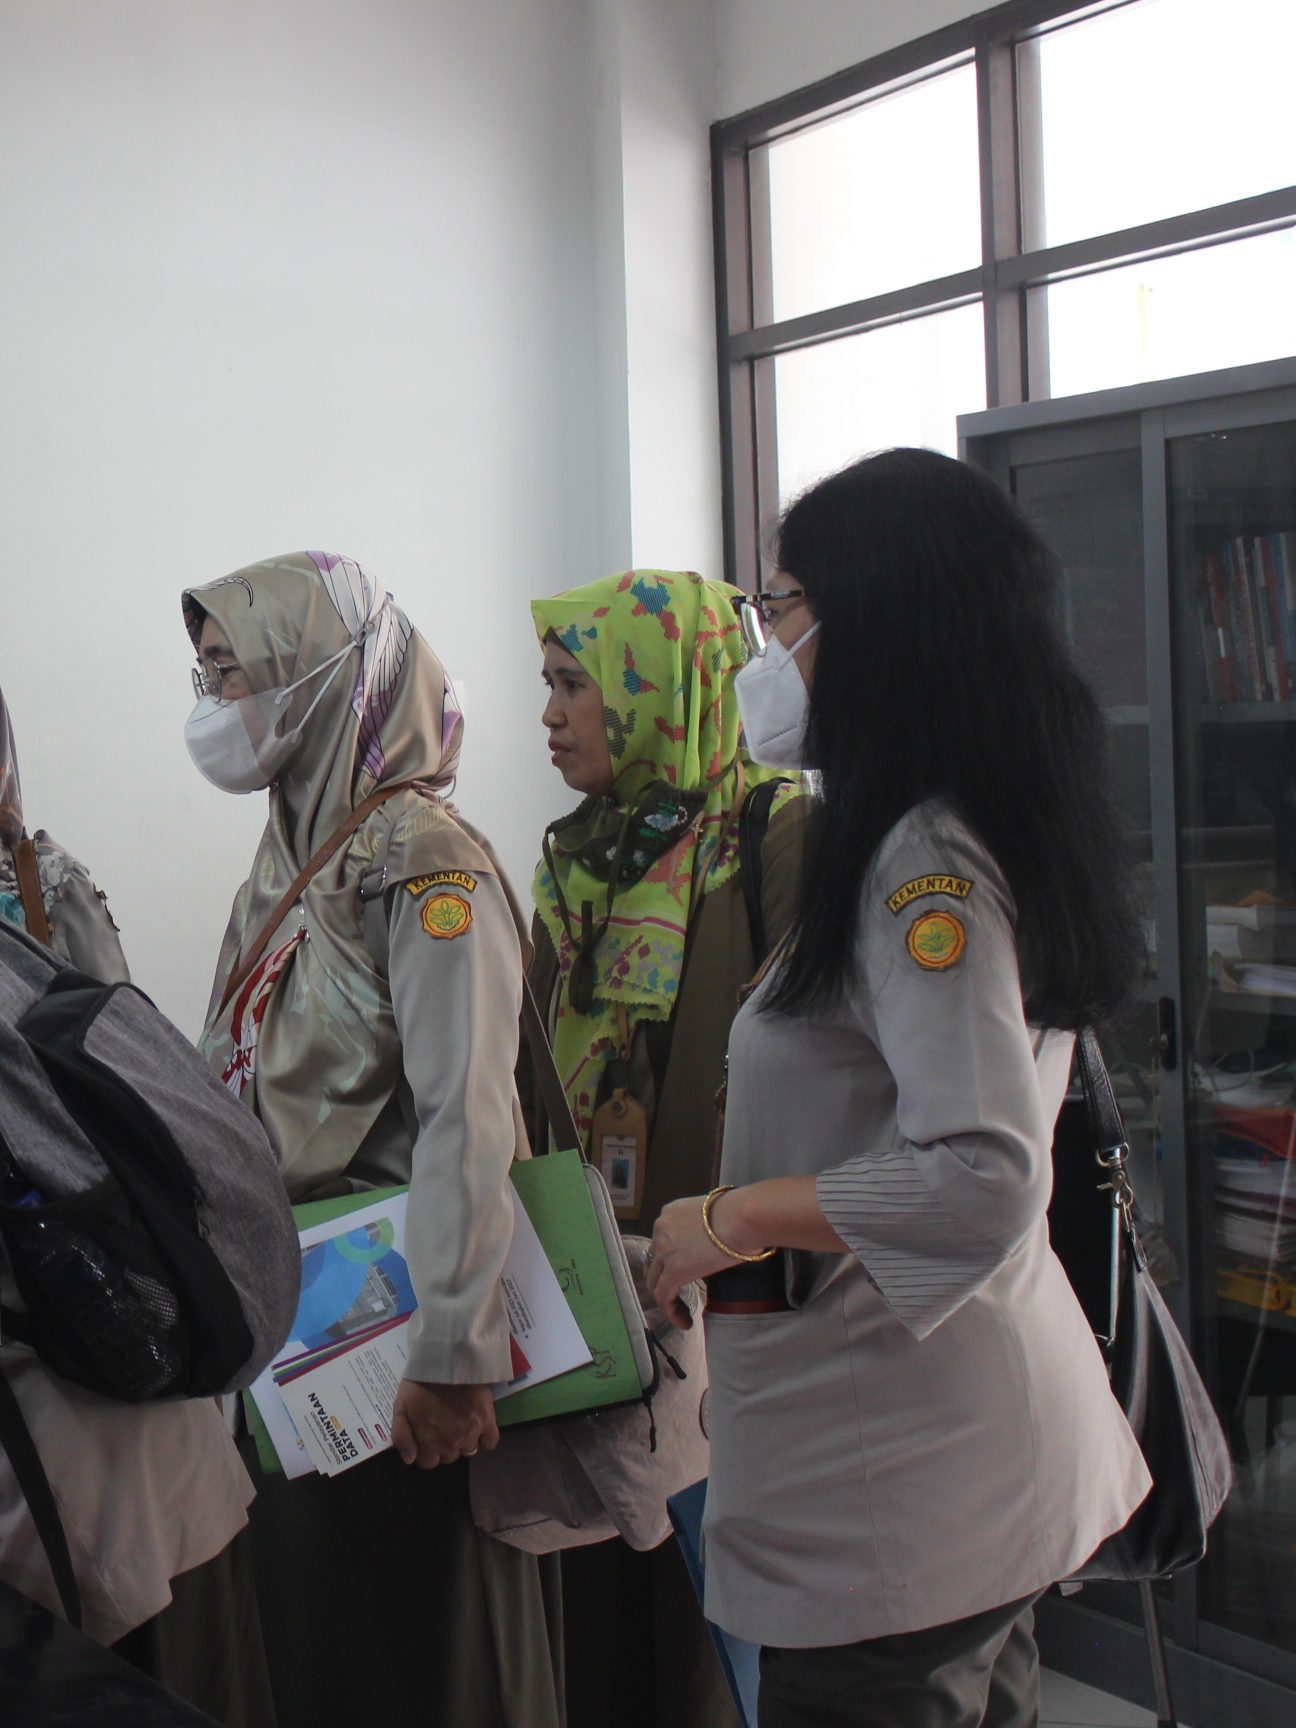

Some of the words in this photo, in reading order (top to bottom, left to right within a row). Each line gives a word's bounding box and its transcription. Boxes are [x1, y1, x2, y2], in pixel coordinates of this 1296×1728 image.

[412, 871, 471, 891] KEMENTAN
[891, 877, 967, 908] KEMENTAN
[307, 1391, 351, 1463] PERMINTAAN
[308, 1410, 330, 1442] Pelayanan
[326, 1441, 342, 1465] Standar
[338, 1428, 359, 1458] DATA
